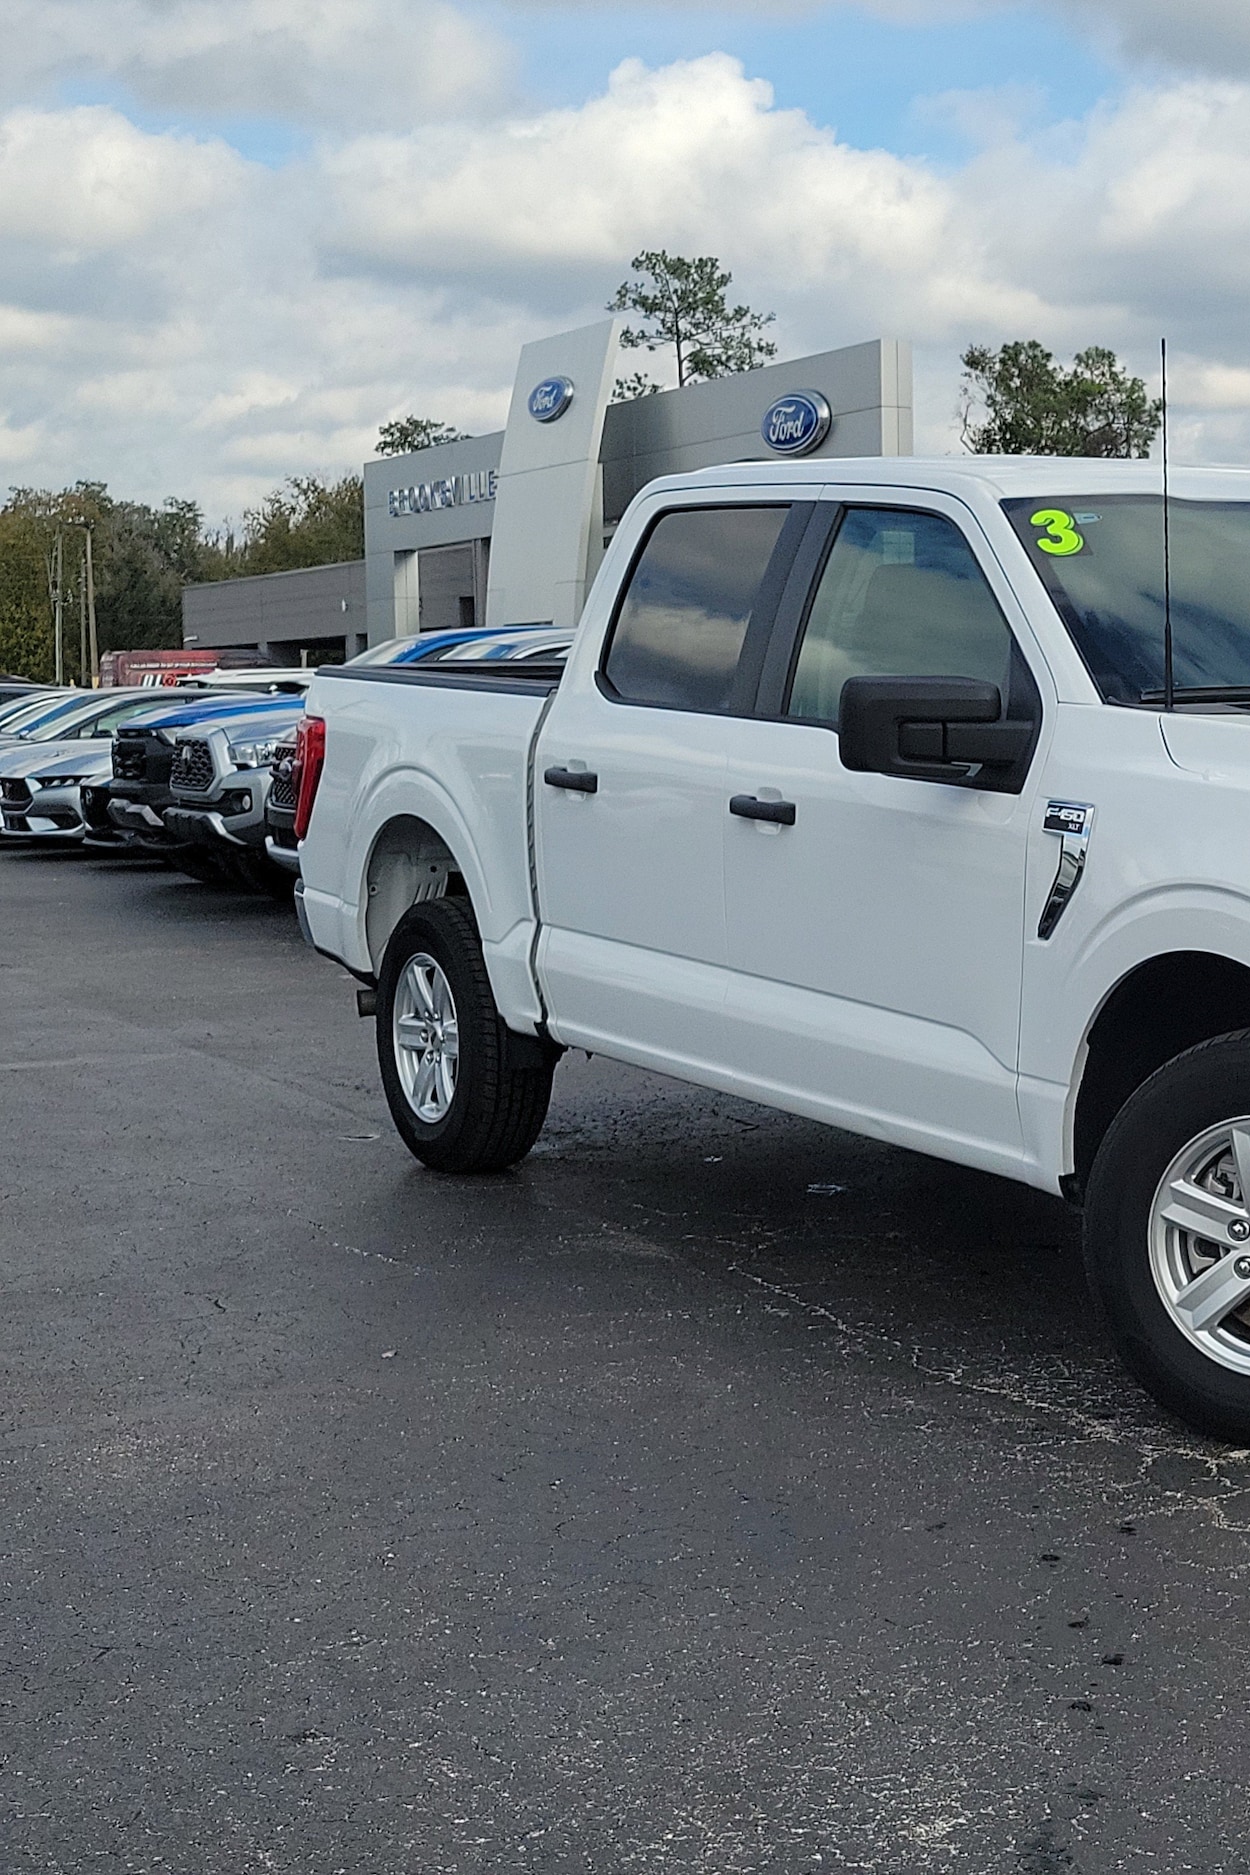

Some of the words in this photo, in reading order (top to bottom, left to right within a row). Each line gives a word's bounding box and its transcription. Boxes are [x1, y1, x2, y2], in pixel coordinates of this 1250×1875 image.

[532, 384, 558, 412] Ford
[769, 404, 805, 442] Ford
[1029, 508, 1084, 556] 3
